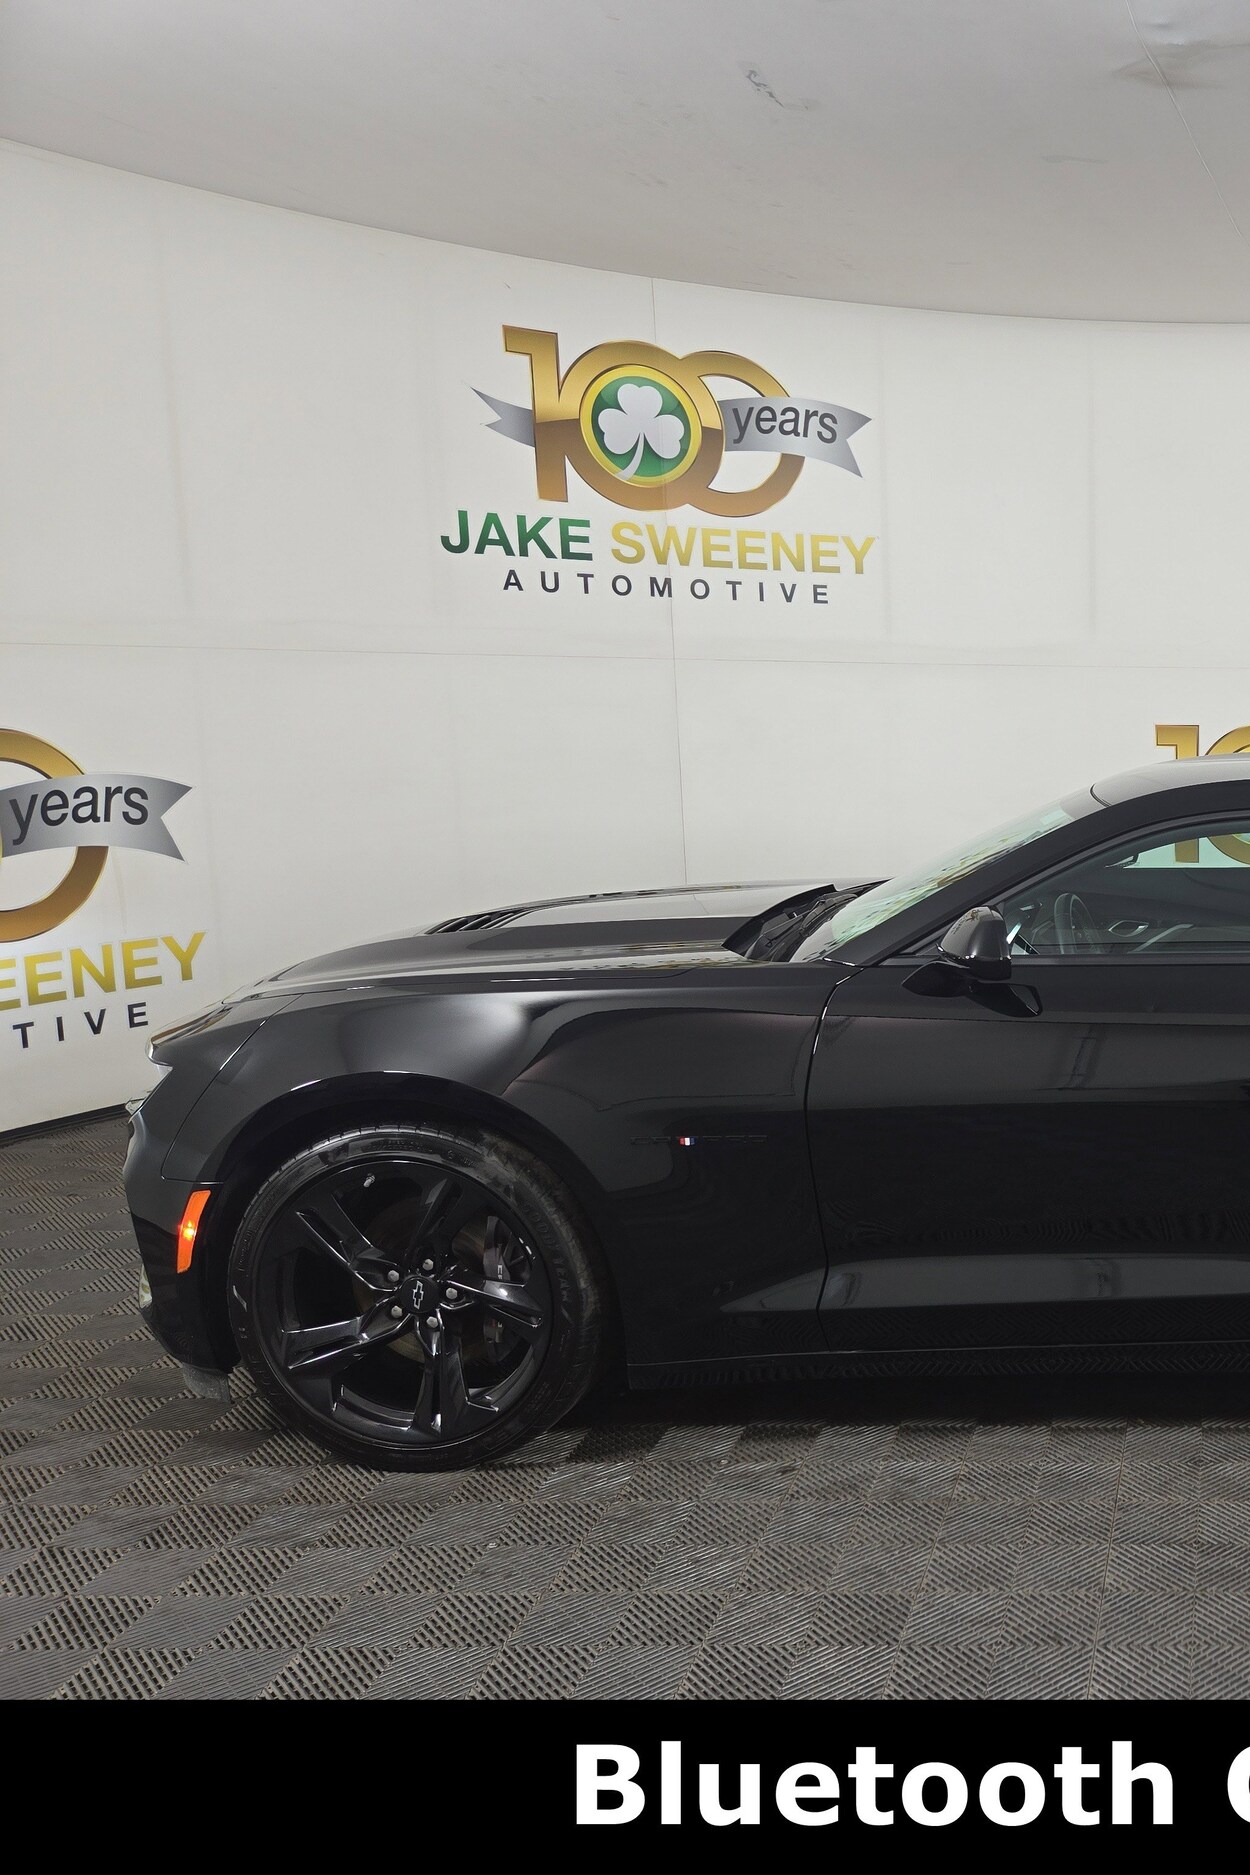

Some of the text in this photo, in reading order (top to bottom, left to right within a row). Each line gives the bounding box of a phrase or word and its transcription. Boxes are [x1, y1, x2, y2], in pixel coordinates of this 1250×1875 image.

[502, 324, 837, 517] 100 years
[440, 510, 875, 574] JAKE SWEENEY
[503, 569, 829, 604] AUTOMOTIVE
[8, 785, 149, 846] years
